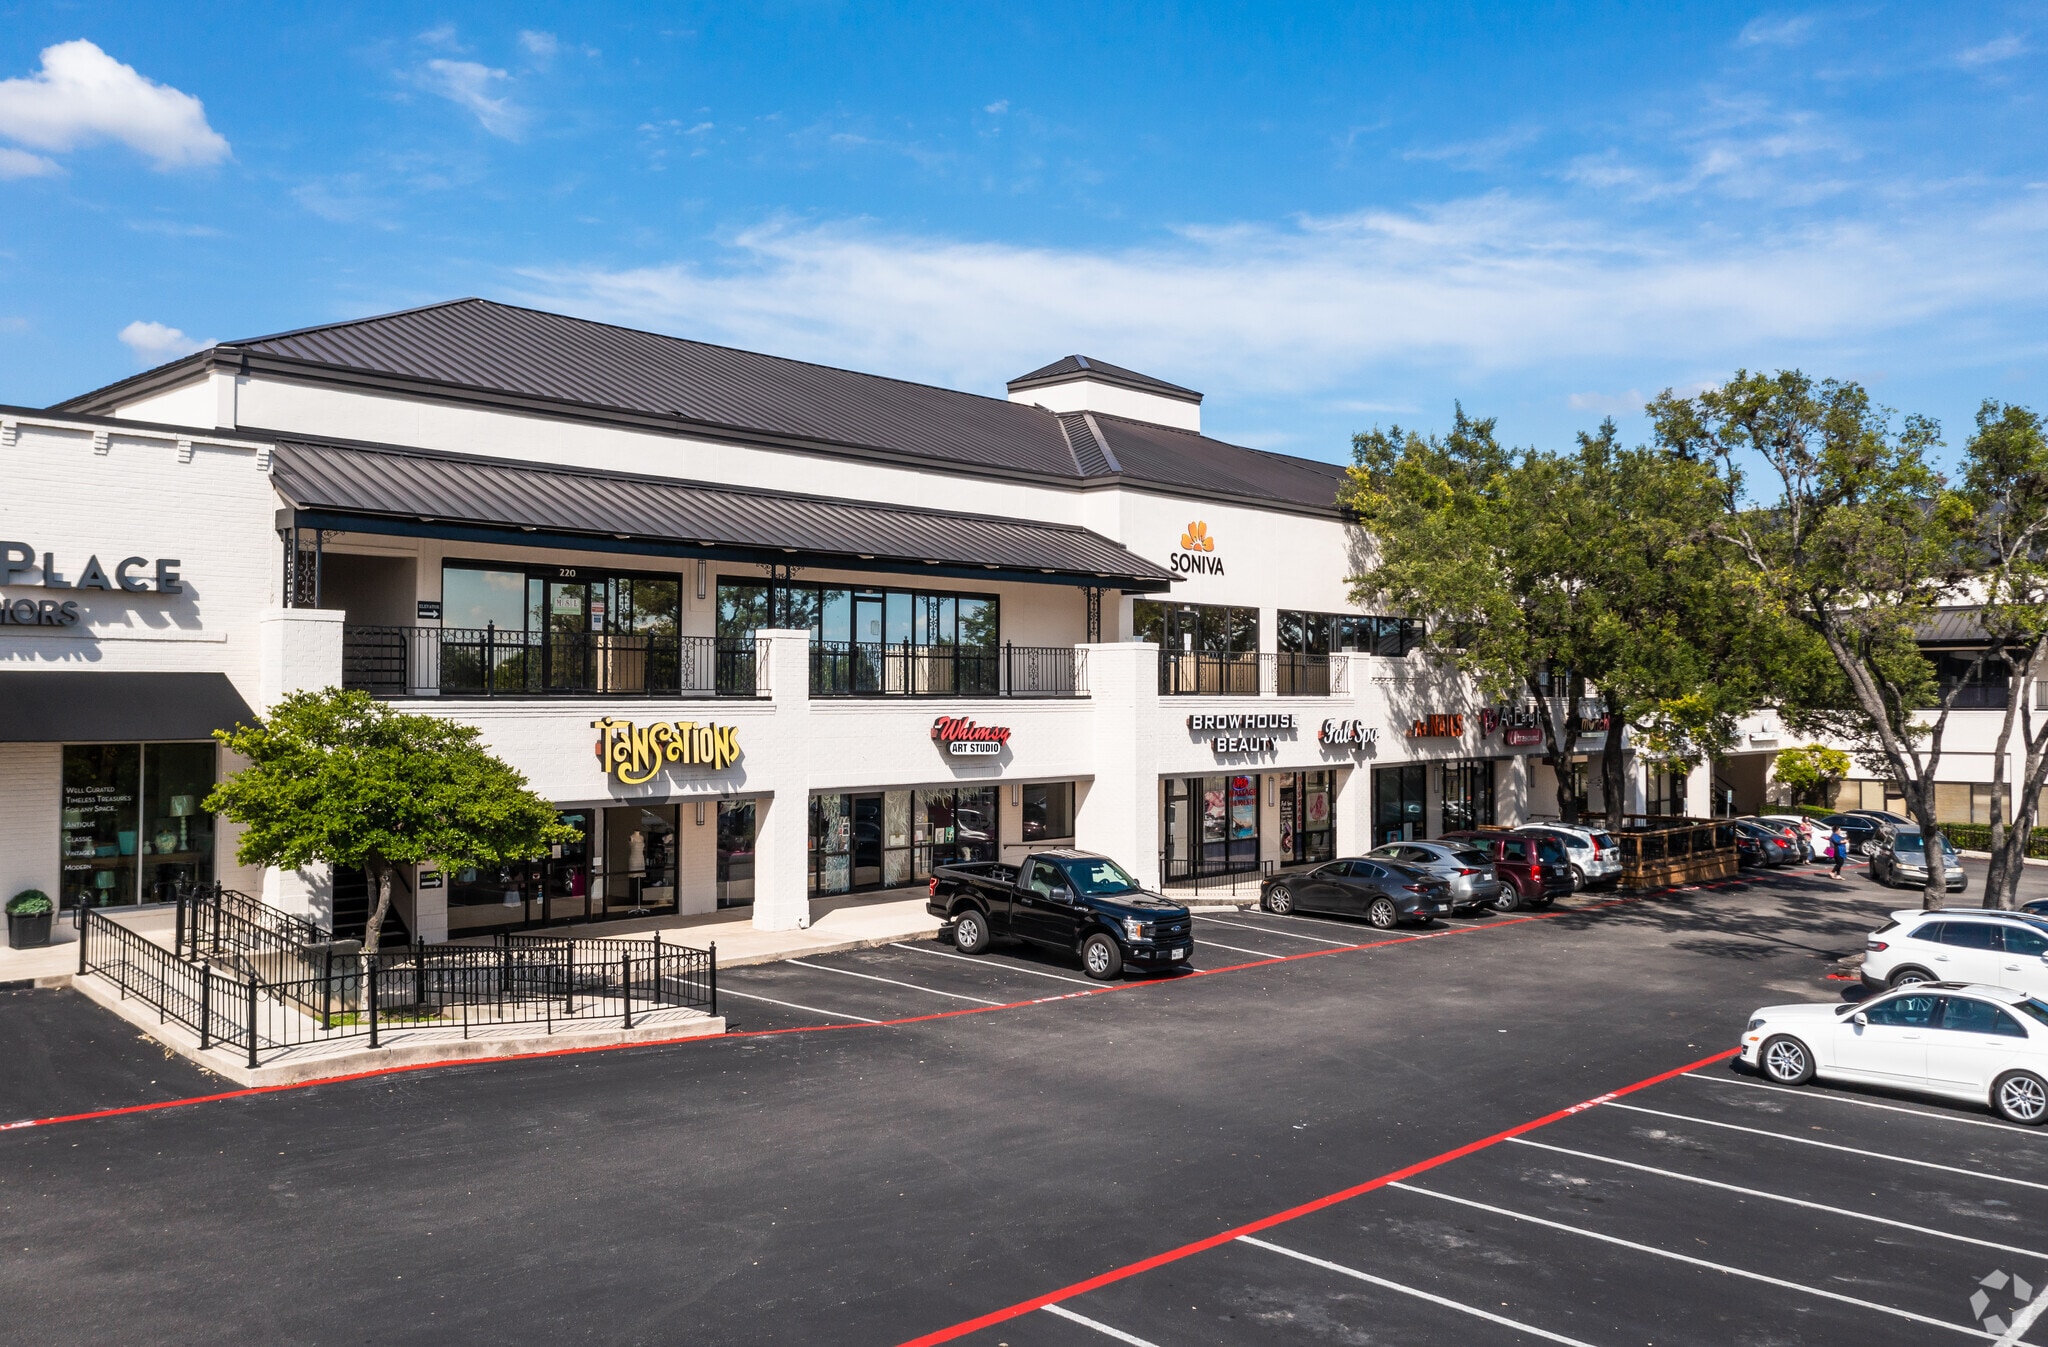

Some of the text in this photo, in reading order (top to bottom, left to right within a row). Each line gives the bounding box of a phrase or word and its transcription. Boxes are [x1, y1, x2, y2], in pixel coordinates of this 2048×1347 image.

[0, 541, 183, 594] PLACE
[559, 569, 577, 577] 220
[1170, 552, 1225, 576] SONIVA
[938, 715, 1012, 747] Whimsy
[1354, 719, 1379, 750] Spa
[1430, 713, 1464, 737] NAILS
[951, 743, 999, 753] ART STUDIO
[1217, 737, 1279, 752] BEAUTY
